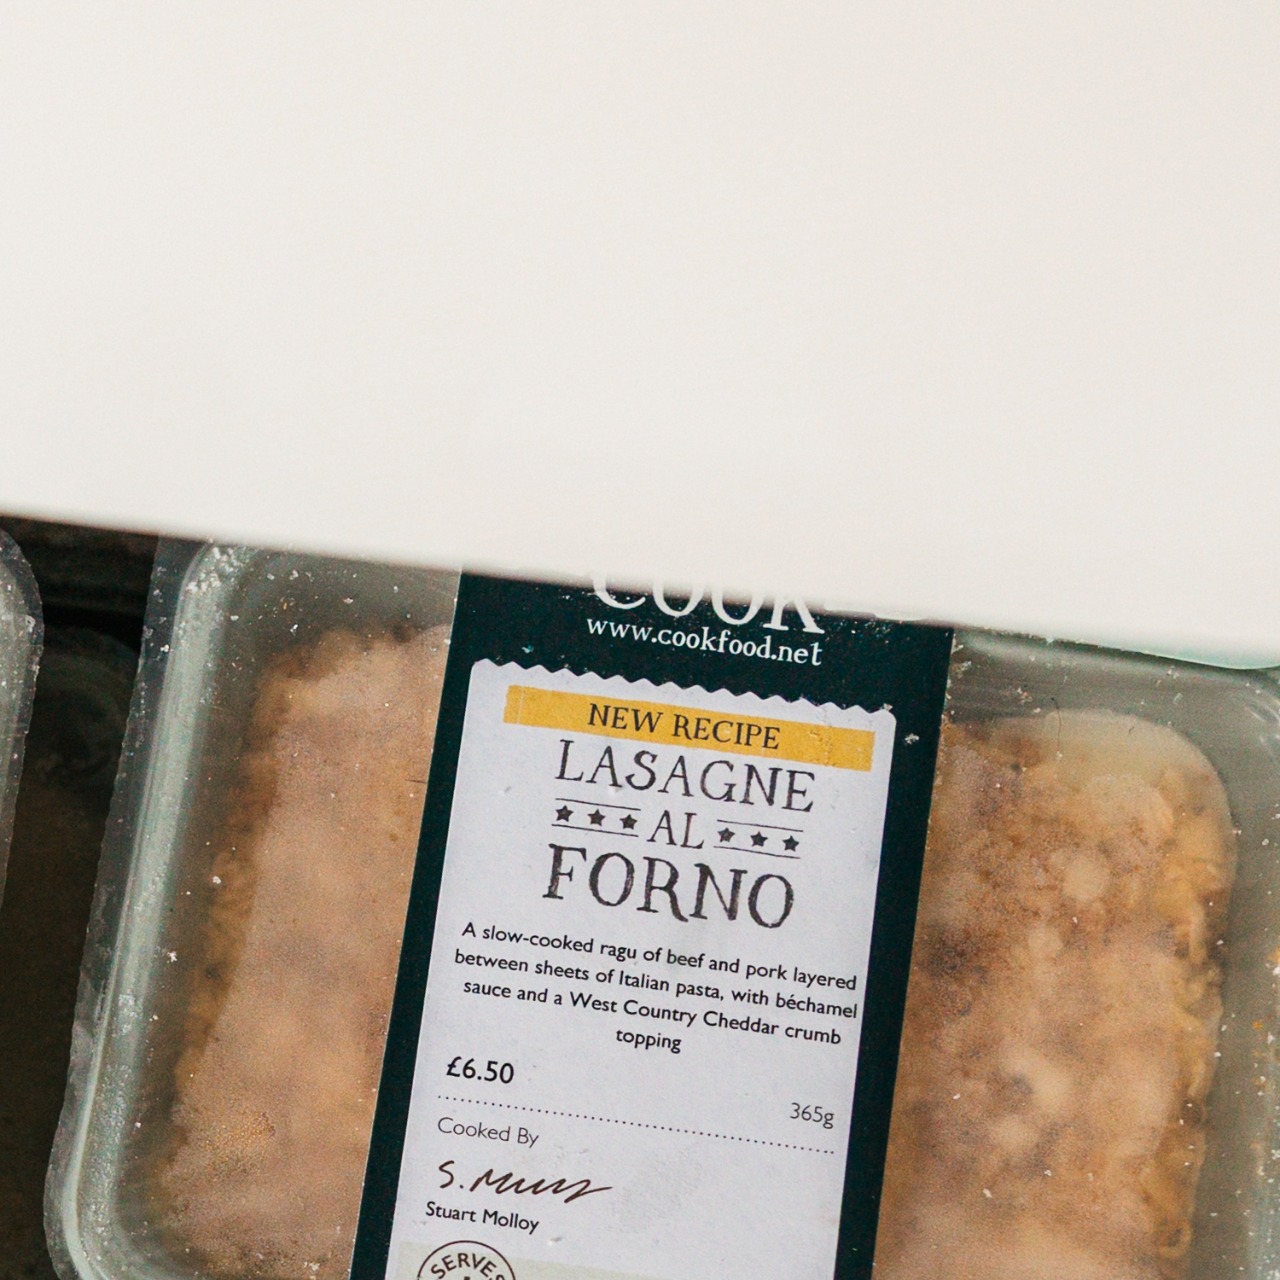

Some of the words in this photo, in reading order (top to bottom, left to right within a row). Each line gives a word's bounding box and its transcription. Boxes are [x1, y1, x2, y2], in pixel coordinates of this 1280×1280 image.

[587, 618, 823, 666] www.cookfood.net
[587, 703, 662, 733] NEW
[672, 714, 781, 751] RECIPE
[555, 739, 816, 813] LASAGNE
[646, 810, 705, 850] AL
[542, 843, 795, 929] FORNO
[462, 922, 476, 937] A
[483, 925, 594, 953] slow-cooked
[600, 944, 637, 962] ragu
[643, 947, 662, 962] of
[667, 949, 705, 968] beef
[709, 958, 740, 973] and
[746, 965, 787, 980] pork
[793, 967, 857, 990] layered
[455, 948, 528, 972] between
[535, 960, 589, 980] sheets
[596, 969, 615, 983] of
[619, 970, 669, 991] Italian
[676, 983, 724, 1001] pasta,
[731, 989, 769, 1005] with
[776, 992, 857, 1018] béchamel
[464, 982, 511, 998] sauce
[517, 988, 548, 1003] and
[554, 994, 562, 1005] a
[570, 991, 617, 1013] West
[623, 1000, 697, 1027] Country
[703, 1011, 779, 1034] Cheddar
[785, 1027, 841, 1044] crumb
[616, 1030, 681, 1054] topping
[446, 1056, 514, 1084] £6.50
[438, 1117, 511, 1141] Cooked
[517, 1127, 539, 1148] By
[790, 1102, 834, 1129] 365g
[426, 1201, 476, 1222] Stuart
[482, 1209, 539, 1235] Molloy
